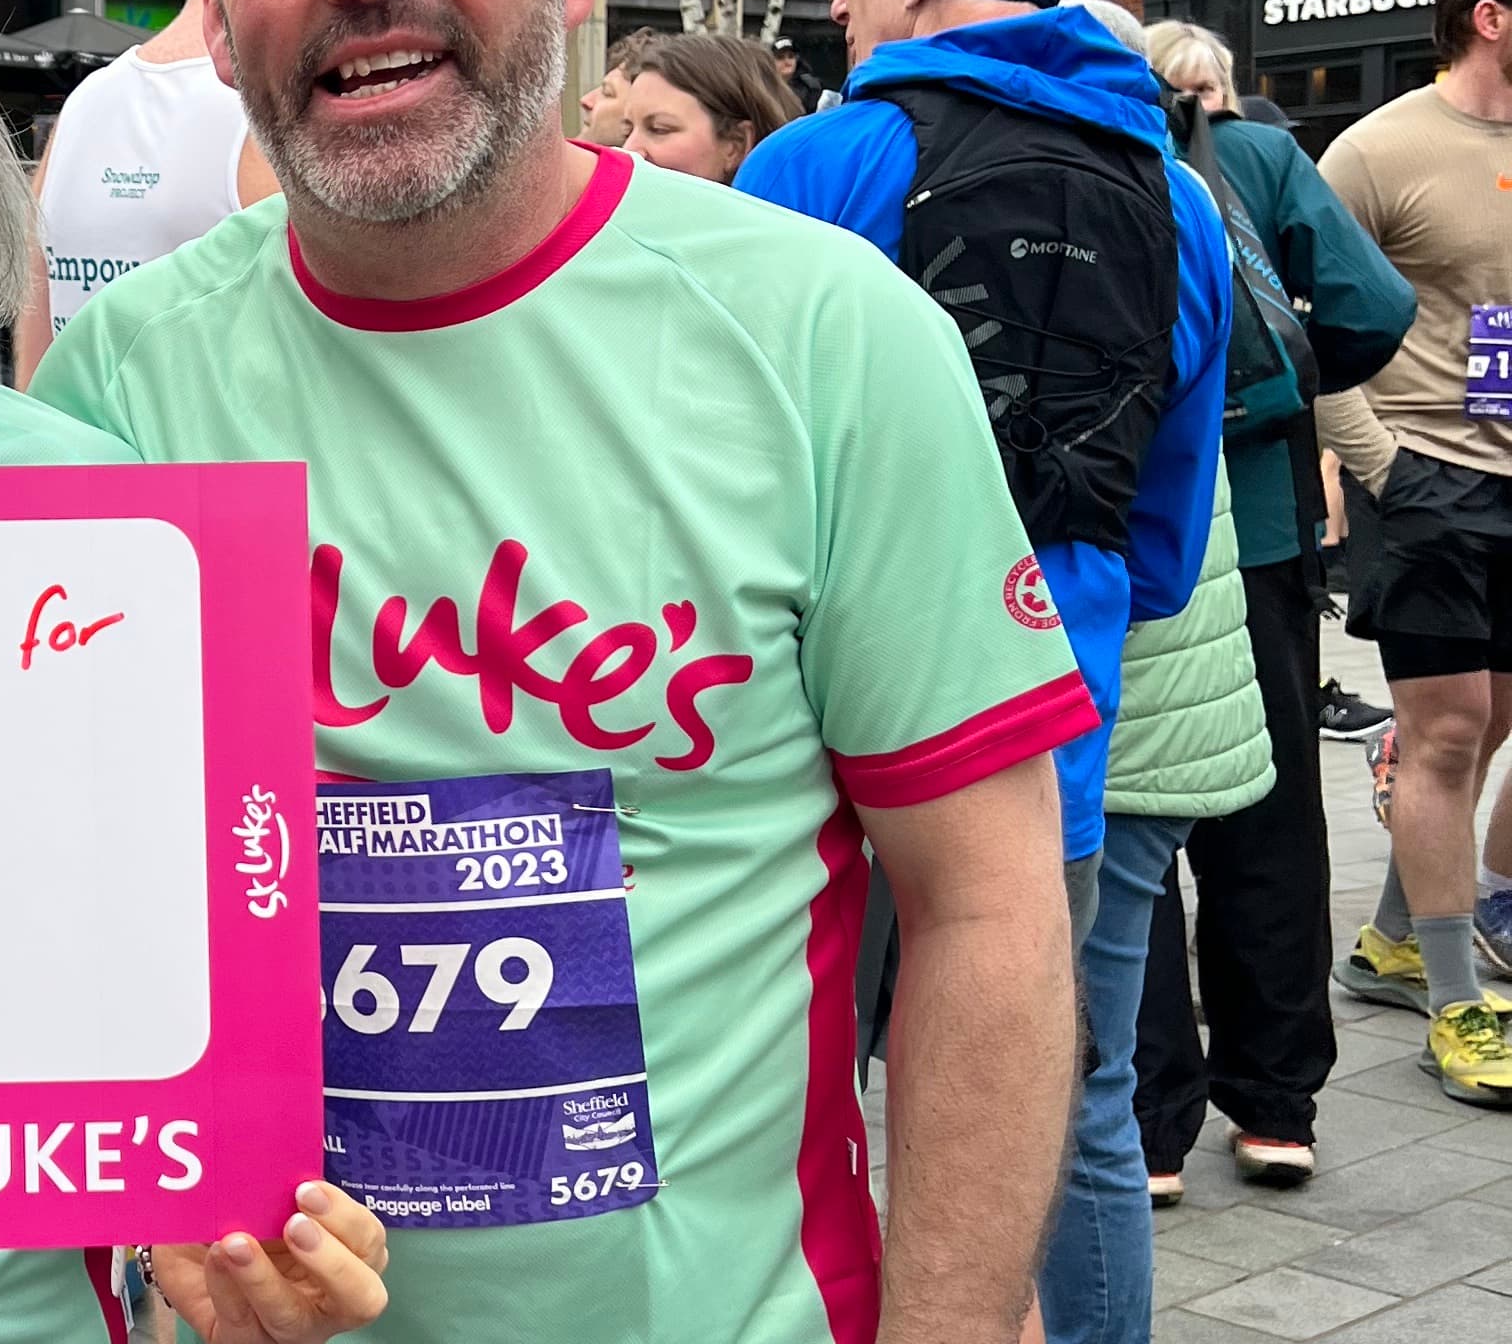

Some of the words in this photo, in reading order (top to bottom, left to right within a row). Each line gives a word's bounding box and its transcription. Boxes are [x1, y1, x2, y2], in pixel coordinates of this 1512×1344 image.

[19, 584, 126, 670] for
[311, 538, 754, 771] Luke's
[231, 783, 277, 874] Luke's
[371, 818, 557, 853] MARATHON
[455, 849, 568, 890] 2023
[245, 877, 288, 918] St
[321, 936, 554, 1034] 679
[562, 1092, 629, 1116] Sheffield
[550, 1161, 644, 1205] 5679
[365, 1194, 442, 1217] Baggage
[445, 1194, 492, 1212] label
